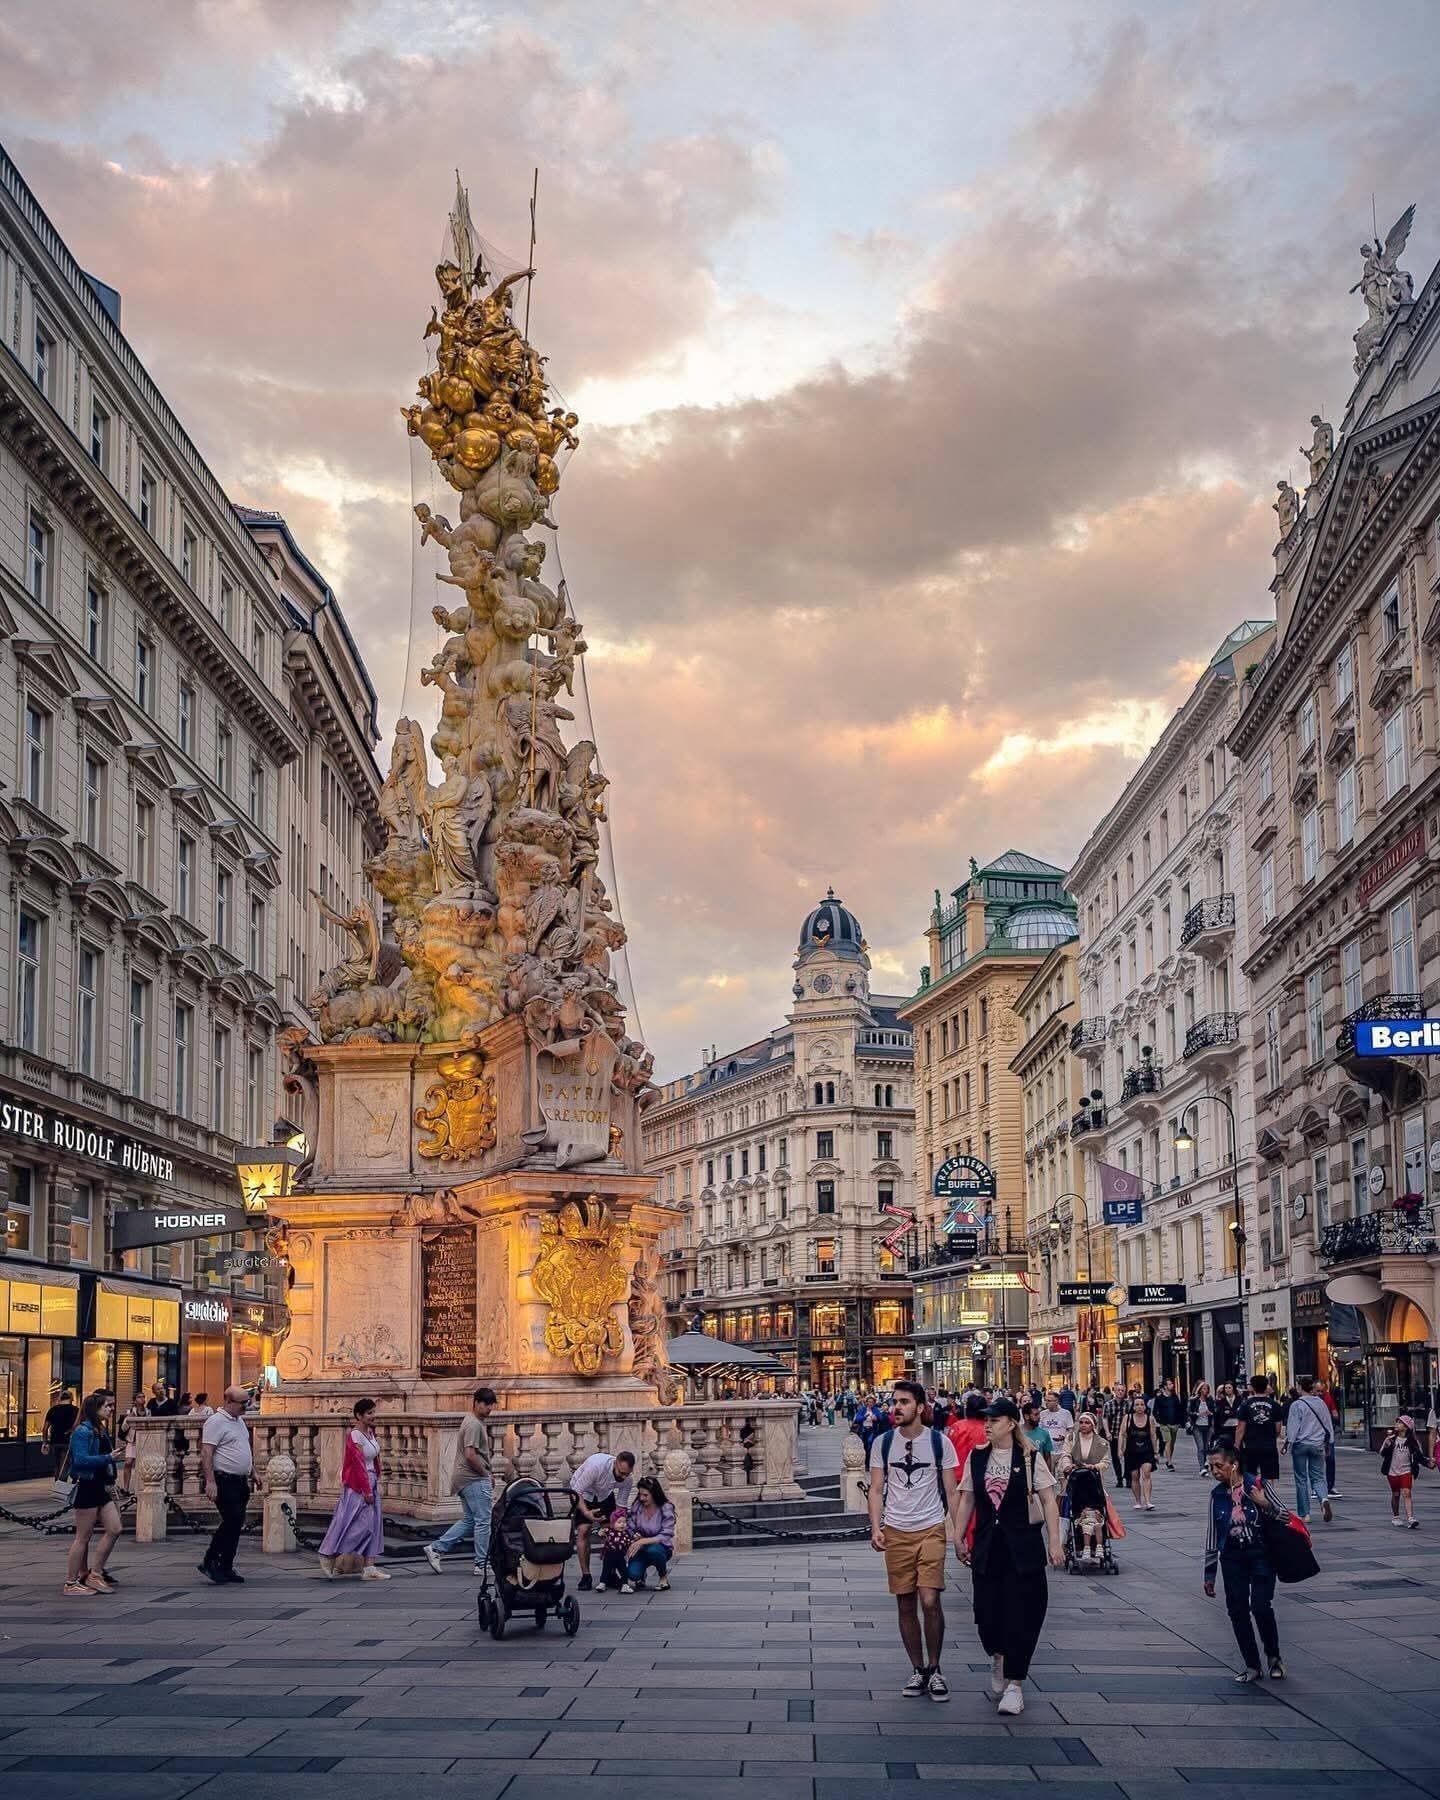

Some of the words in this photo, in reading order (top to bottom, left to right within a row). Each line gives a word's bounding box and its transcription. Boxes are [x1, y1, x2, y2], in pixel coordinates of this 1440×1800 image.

[1371, 1022, 1440, 1049] Berli
[551, 1056, 600, 1077] DEO
[544, 1083, 603, 1101] PATRI
[54, 1120, 115, 1161] RUDOLF
[122, 1142, 173, 1181] HÜBNER
[948, 1180, 981, 1189] BUFFET
[1108, 1202, 1136, 1215] LPE
[154, 1214, 227, 1228] HÜBNER
[223, 1256, 280, 1269] swatch
[1144, 1287, 1166, 1297] IWC
